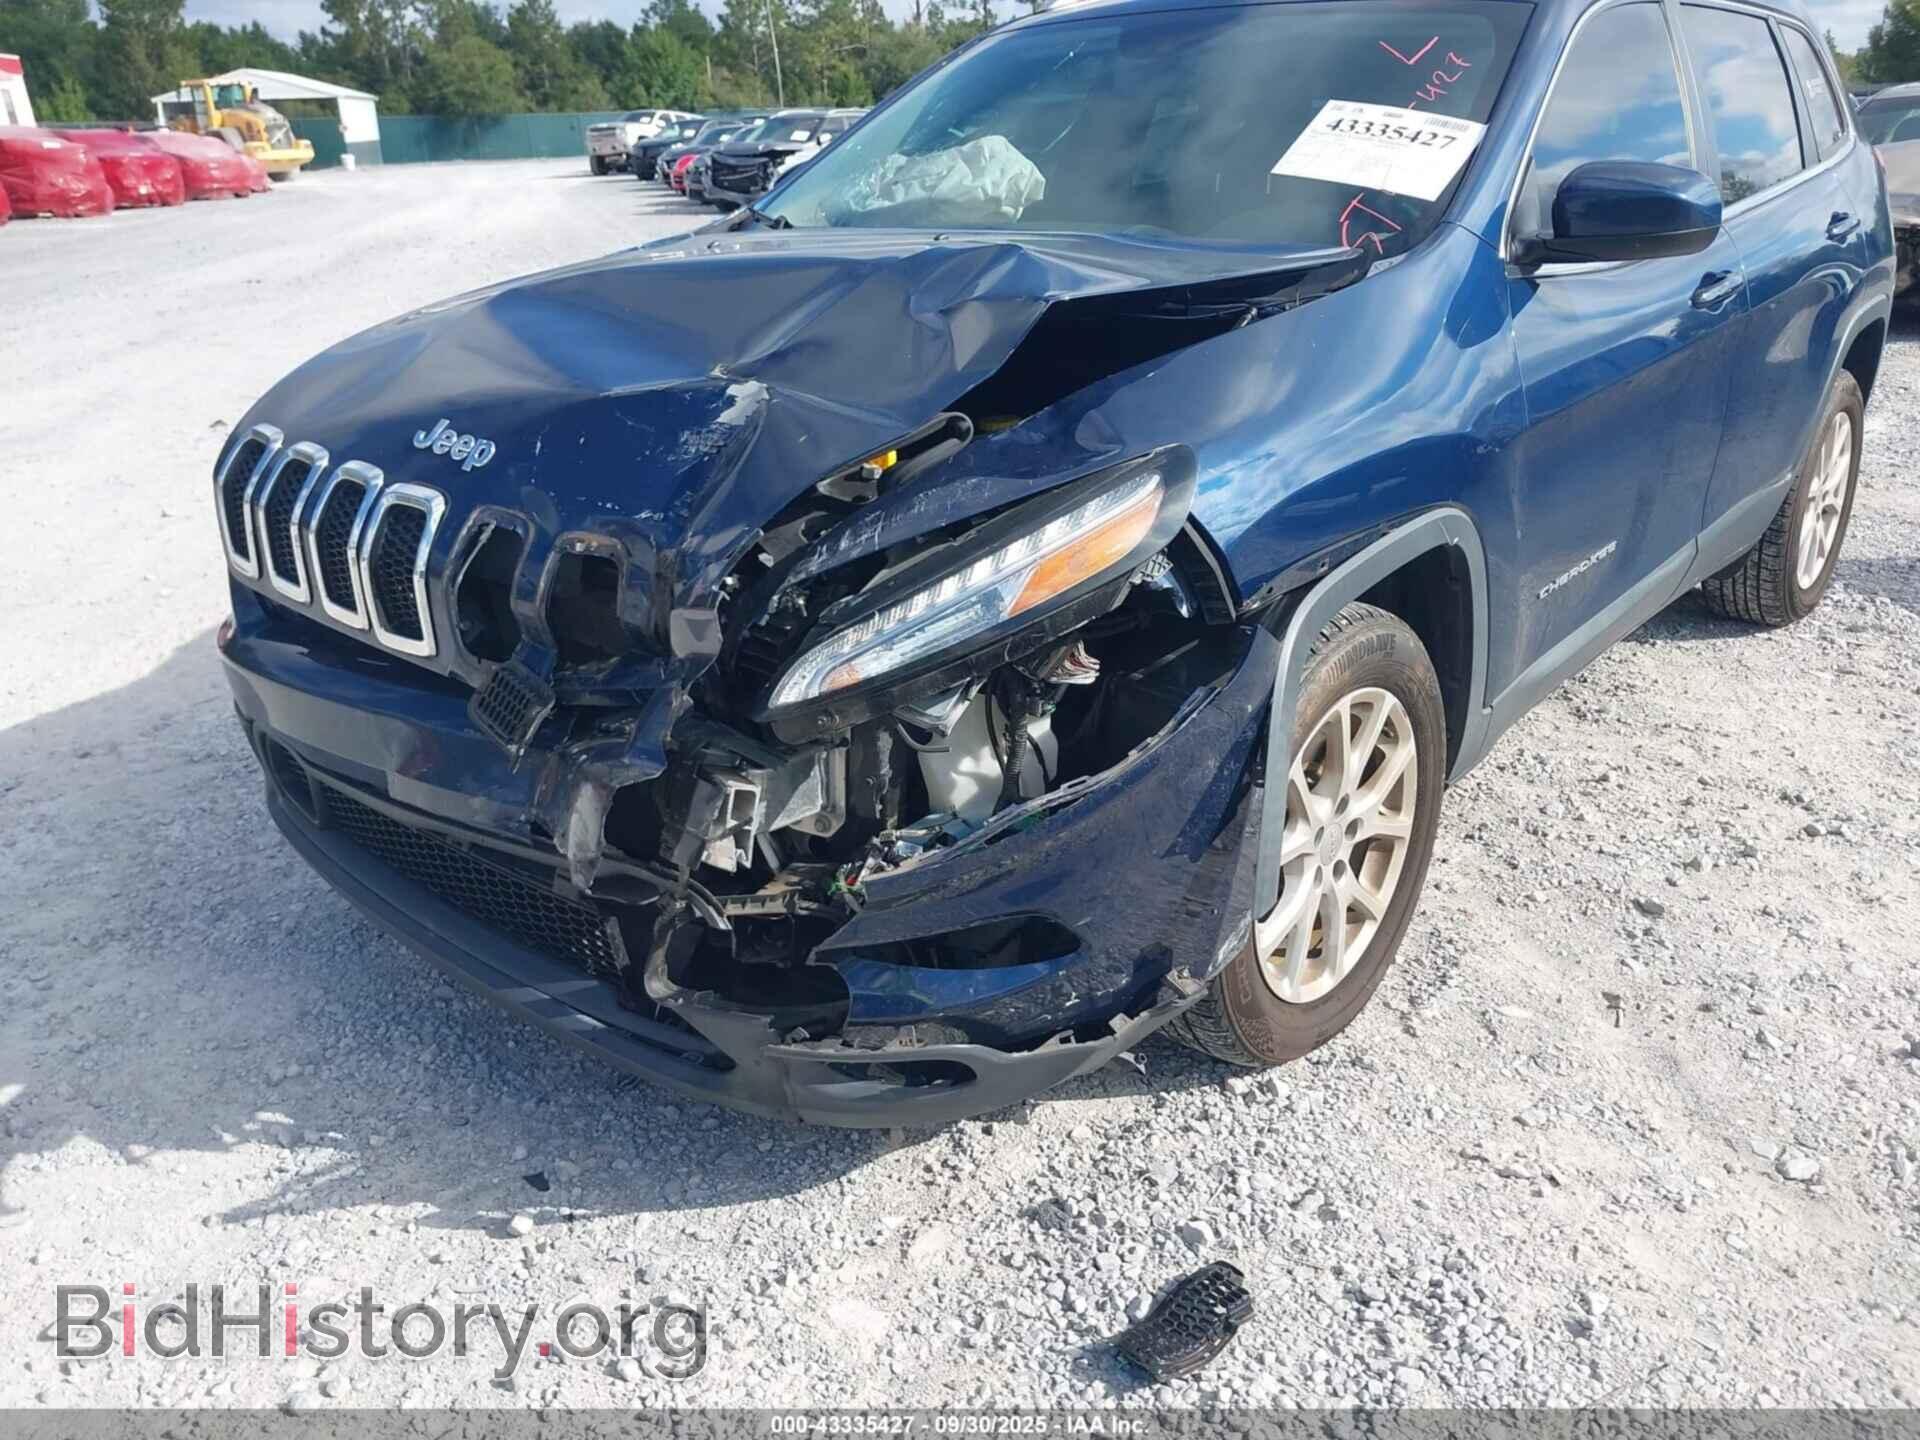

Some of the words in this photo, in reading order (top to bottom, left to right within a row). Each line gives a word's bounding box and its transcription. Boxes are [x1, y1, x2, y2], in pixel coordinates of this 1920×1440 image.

[1326, 117, 1458, 150] 43335427
[413, 418, 496, 472] Jeep
[1539, 540, 1618, 600] CHEROKEE
